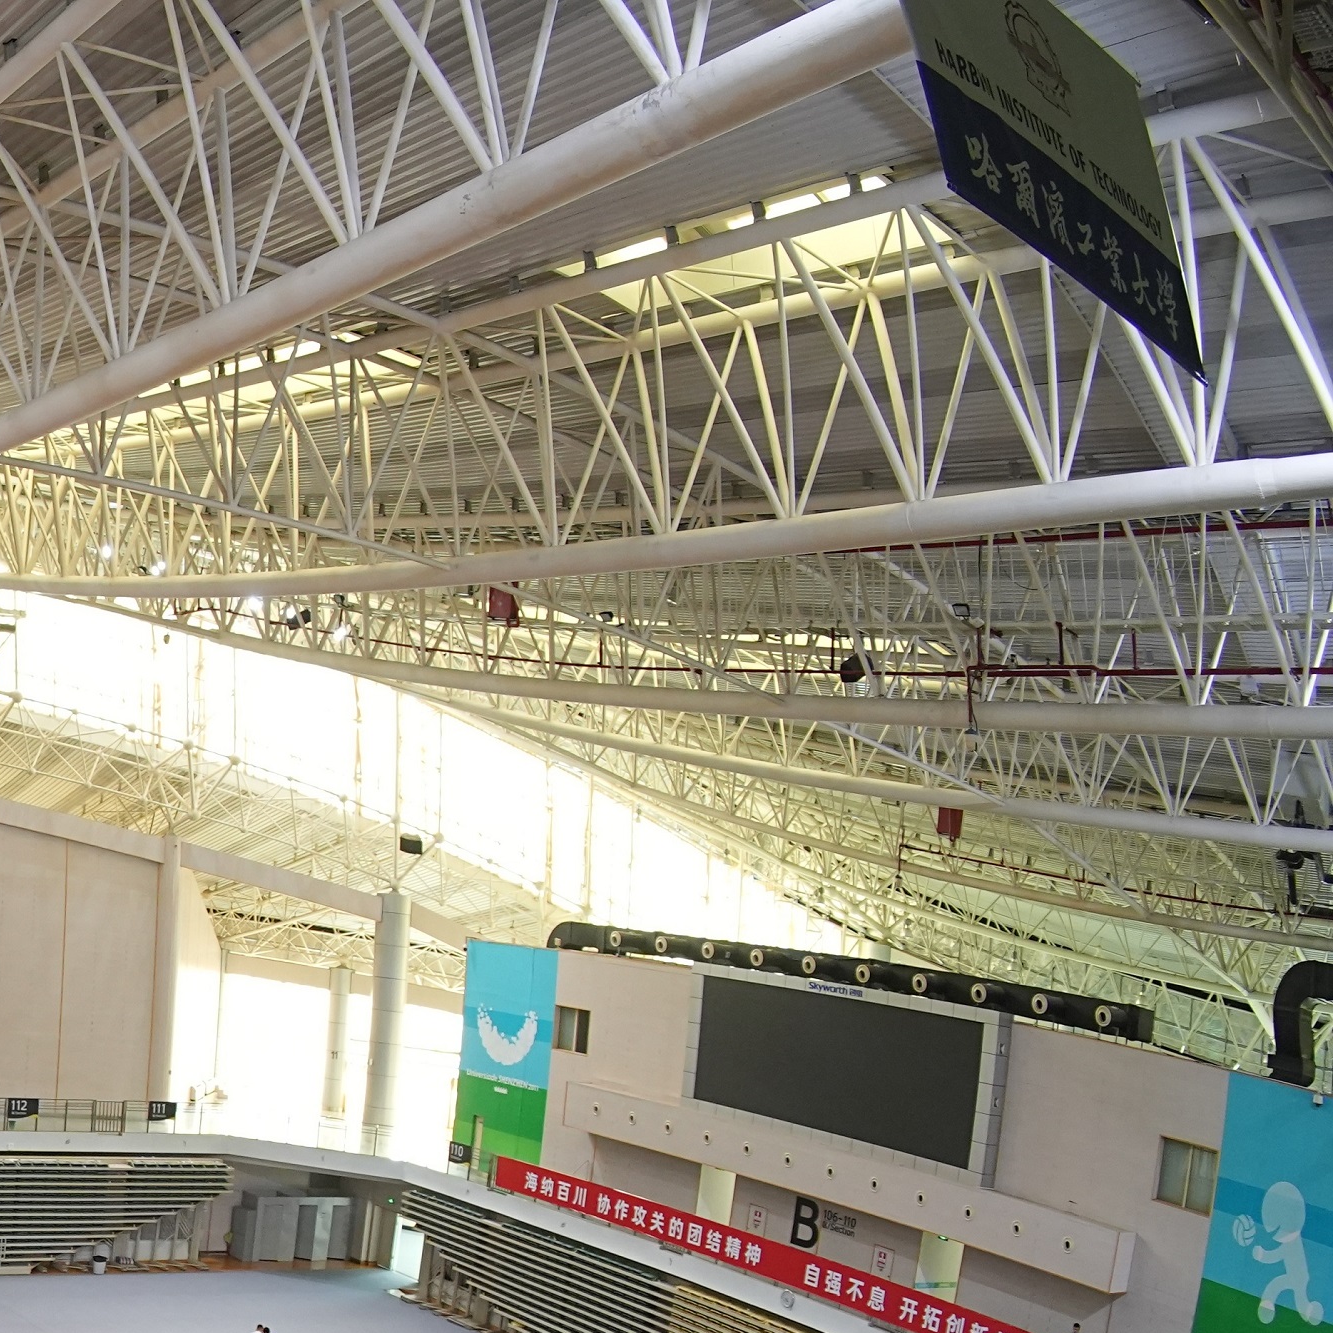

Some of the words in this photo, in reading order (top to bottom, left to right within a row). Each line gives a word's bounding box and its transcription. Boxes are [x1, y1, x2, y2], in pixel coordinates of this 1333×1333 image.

[934, 38, 993, 98] HARBIN
[997, 88, 1067, 158] INSTITUTE
[1069, 143, 1087, 173] OF
[1089, 160, 1163, 240] TECHNOLOGY
[808, 982, 848, 995] Skyworth
[11, 1100, 28, 1111] 112
[152, 1103, 166, 1114] 111
[451, 1143, 464, 1157] 110
[790, 1196, 819, 1248] B
[823, 1209, 857, 1228] 106-110
[524, 1171, 588, 1207] 海纳百川
[597, 1193, 762, 1266] 协作攻关的团结精神
[803, 1263, 887, 1312] 自强不息
